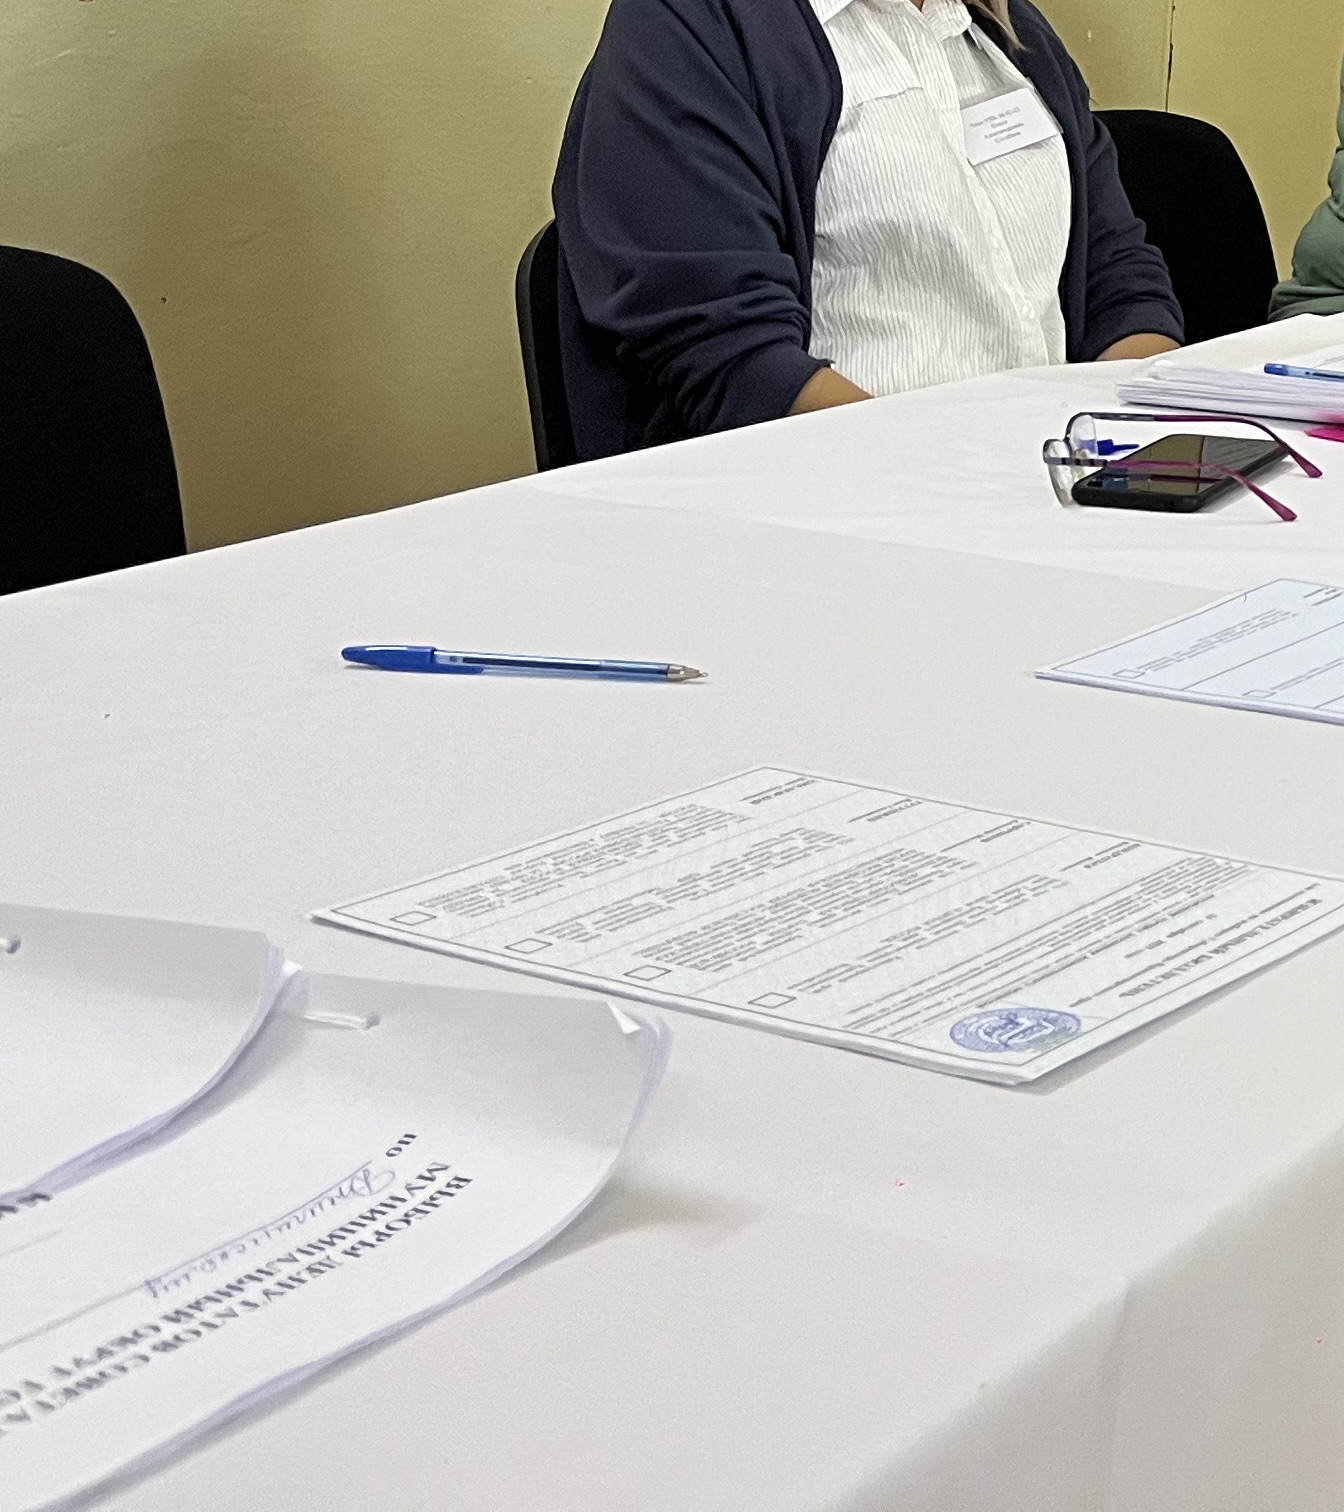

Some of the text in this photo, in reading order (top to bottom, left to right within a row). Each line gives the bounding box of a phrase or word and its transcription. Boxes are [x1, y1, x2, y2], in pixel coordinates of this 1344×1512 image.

[385, 1133, 418, 1158] по
[160, 1161, 452, 1325] МУНИЦИПАЛЬНЫЙ
[346, 1175, 473, 1260] ВЫБОРЫ
[151, 1256, 344, 1355] ДЕПУТАТОВ
